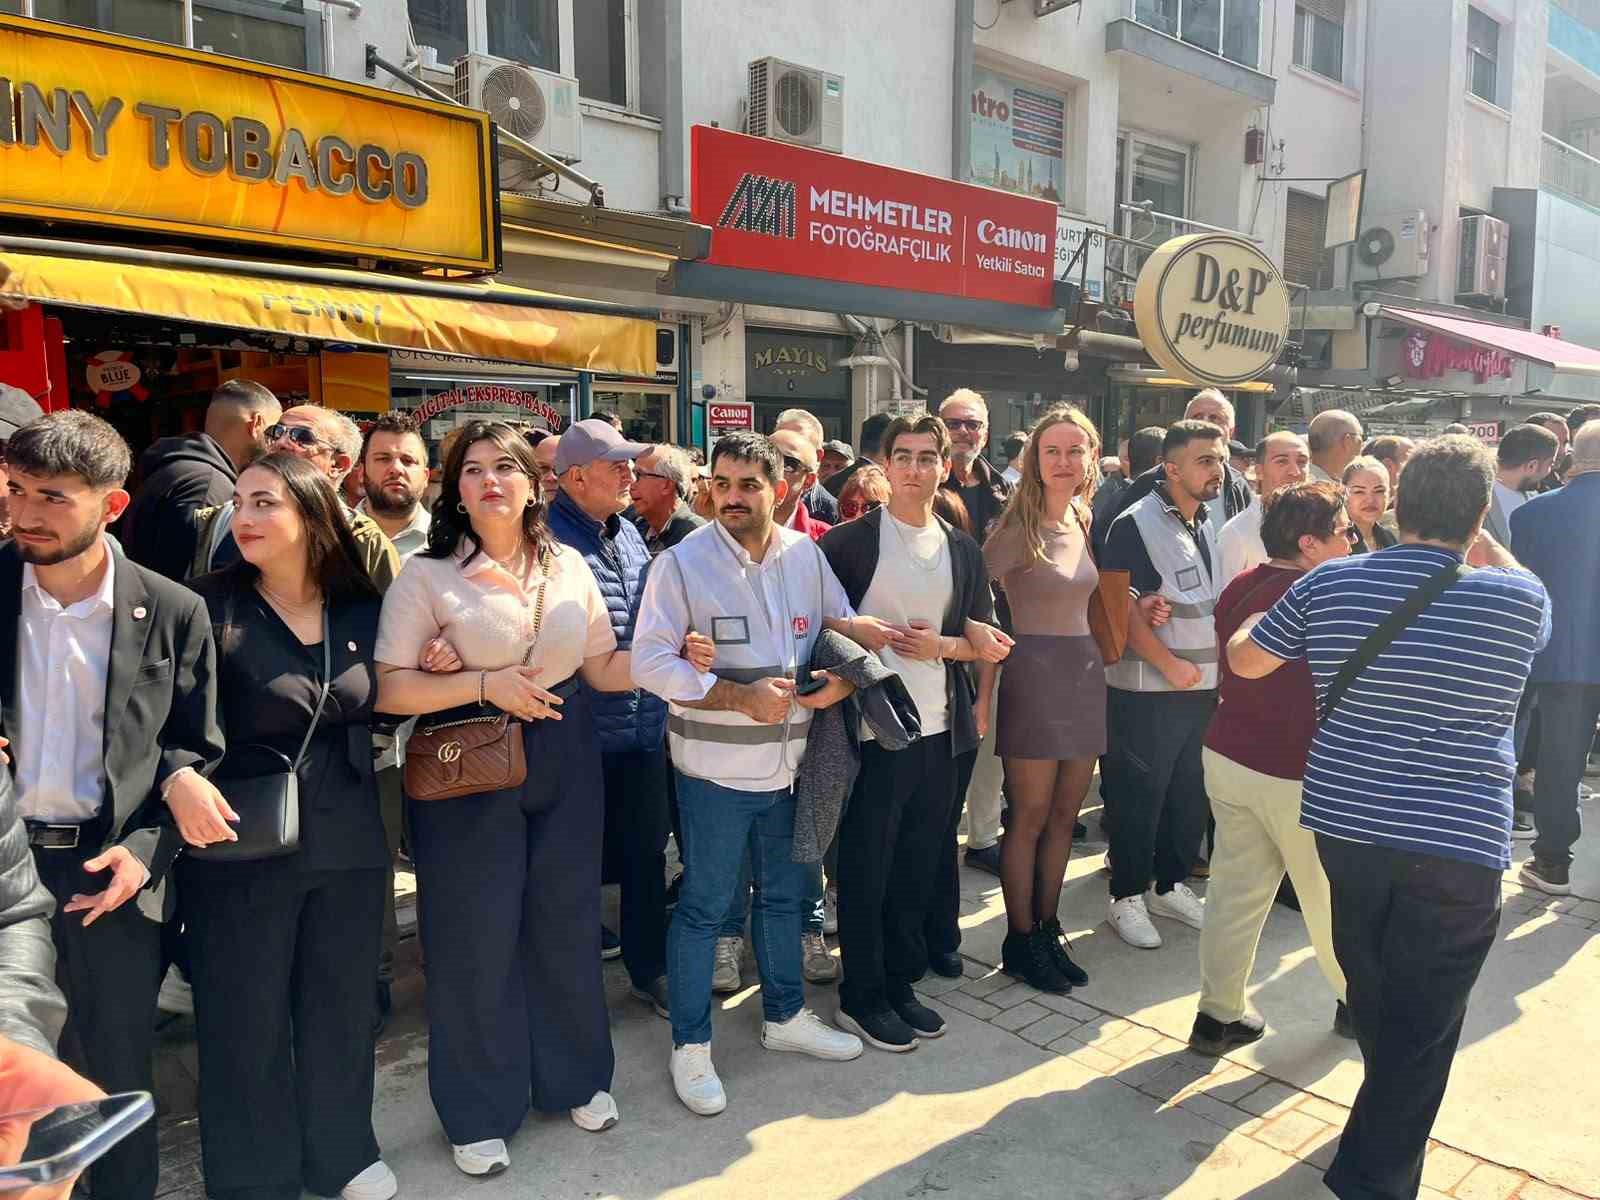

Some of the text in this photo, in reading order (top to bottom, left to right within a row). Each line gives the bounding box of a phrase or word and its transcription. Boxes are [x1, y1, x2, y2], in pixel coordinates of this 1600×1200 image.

[134, 102, 429, 208] TOBACCO
[810, 185, 952, 236] MEHMETLER
[809, 220, 952, 263] FOTOĞRAFÇILIK
[977, 219, 1047, 253] Canon
[976, 253, 1045, 278] Yetkili Satıcı
[1173, 311, 1279, 353] perfumum
[101, 369, 130, 384] BLUE
[753, 347, 827, 372] MAYIS
[466, 384, 525, 407] EKSPRES
[523, 391, 561, 431] BASKI
[711, 406, 748, 418] Canon
